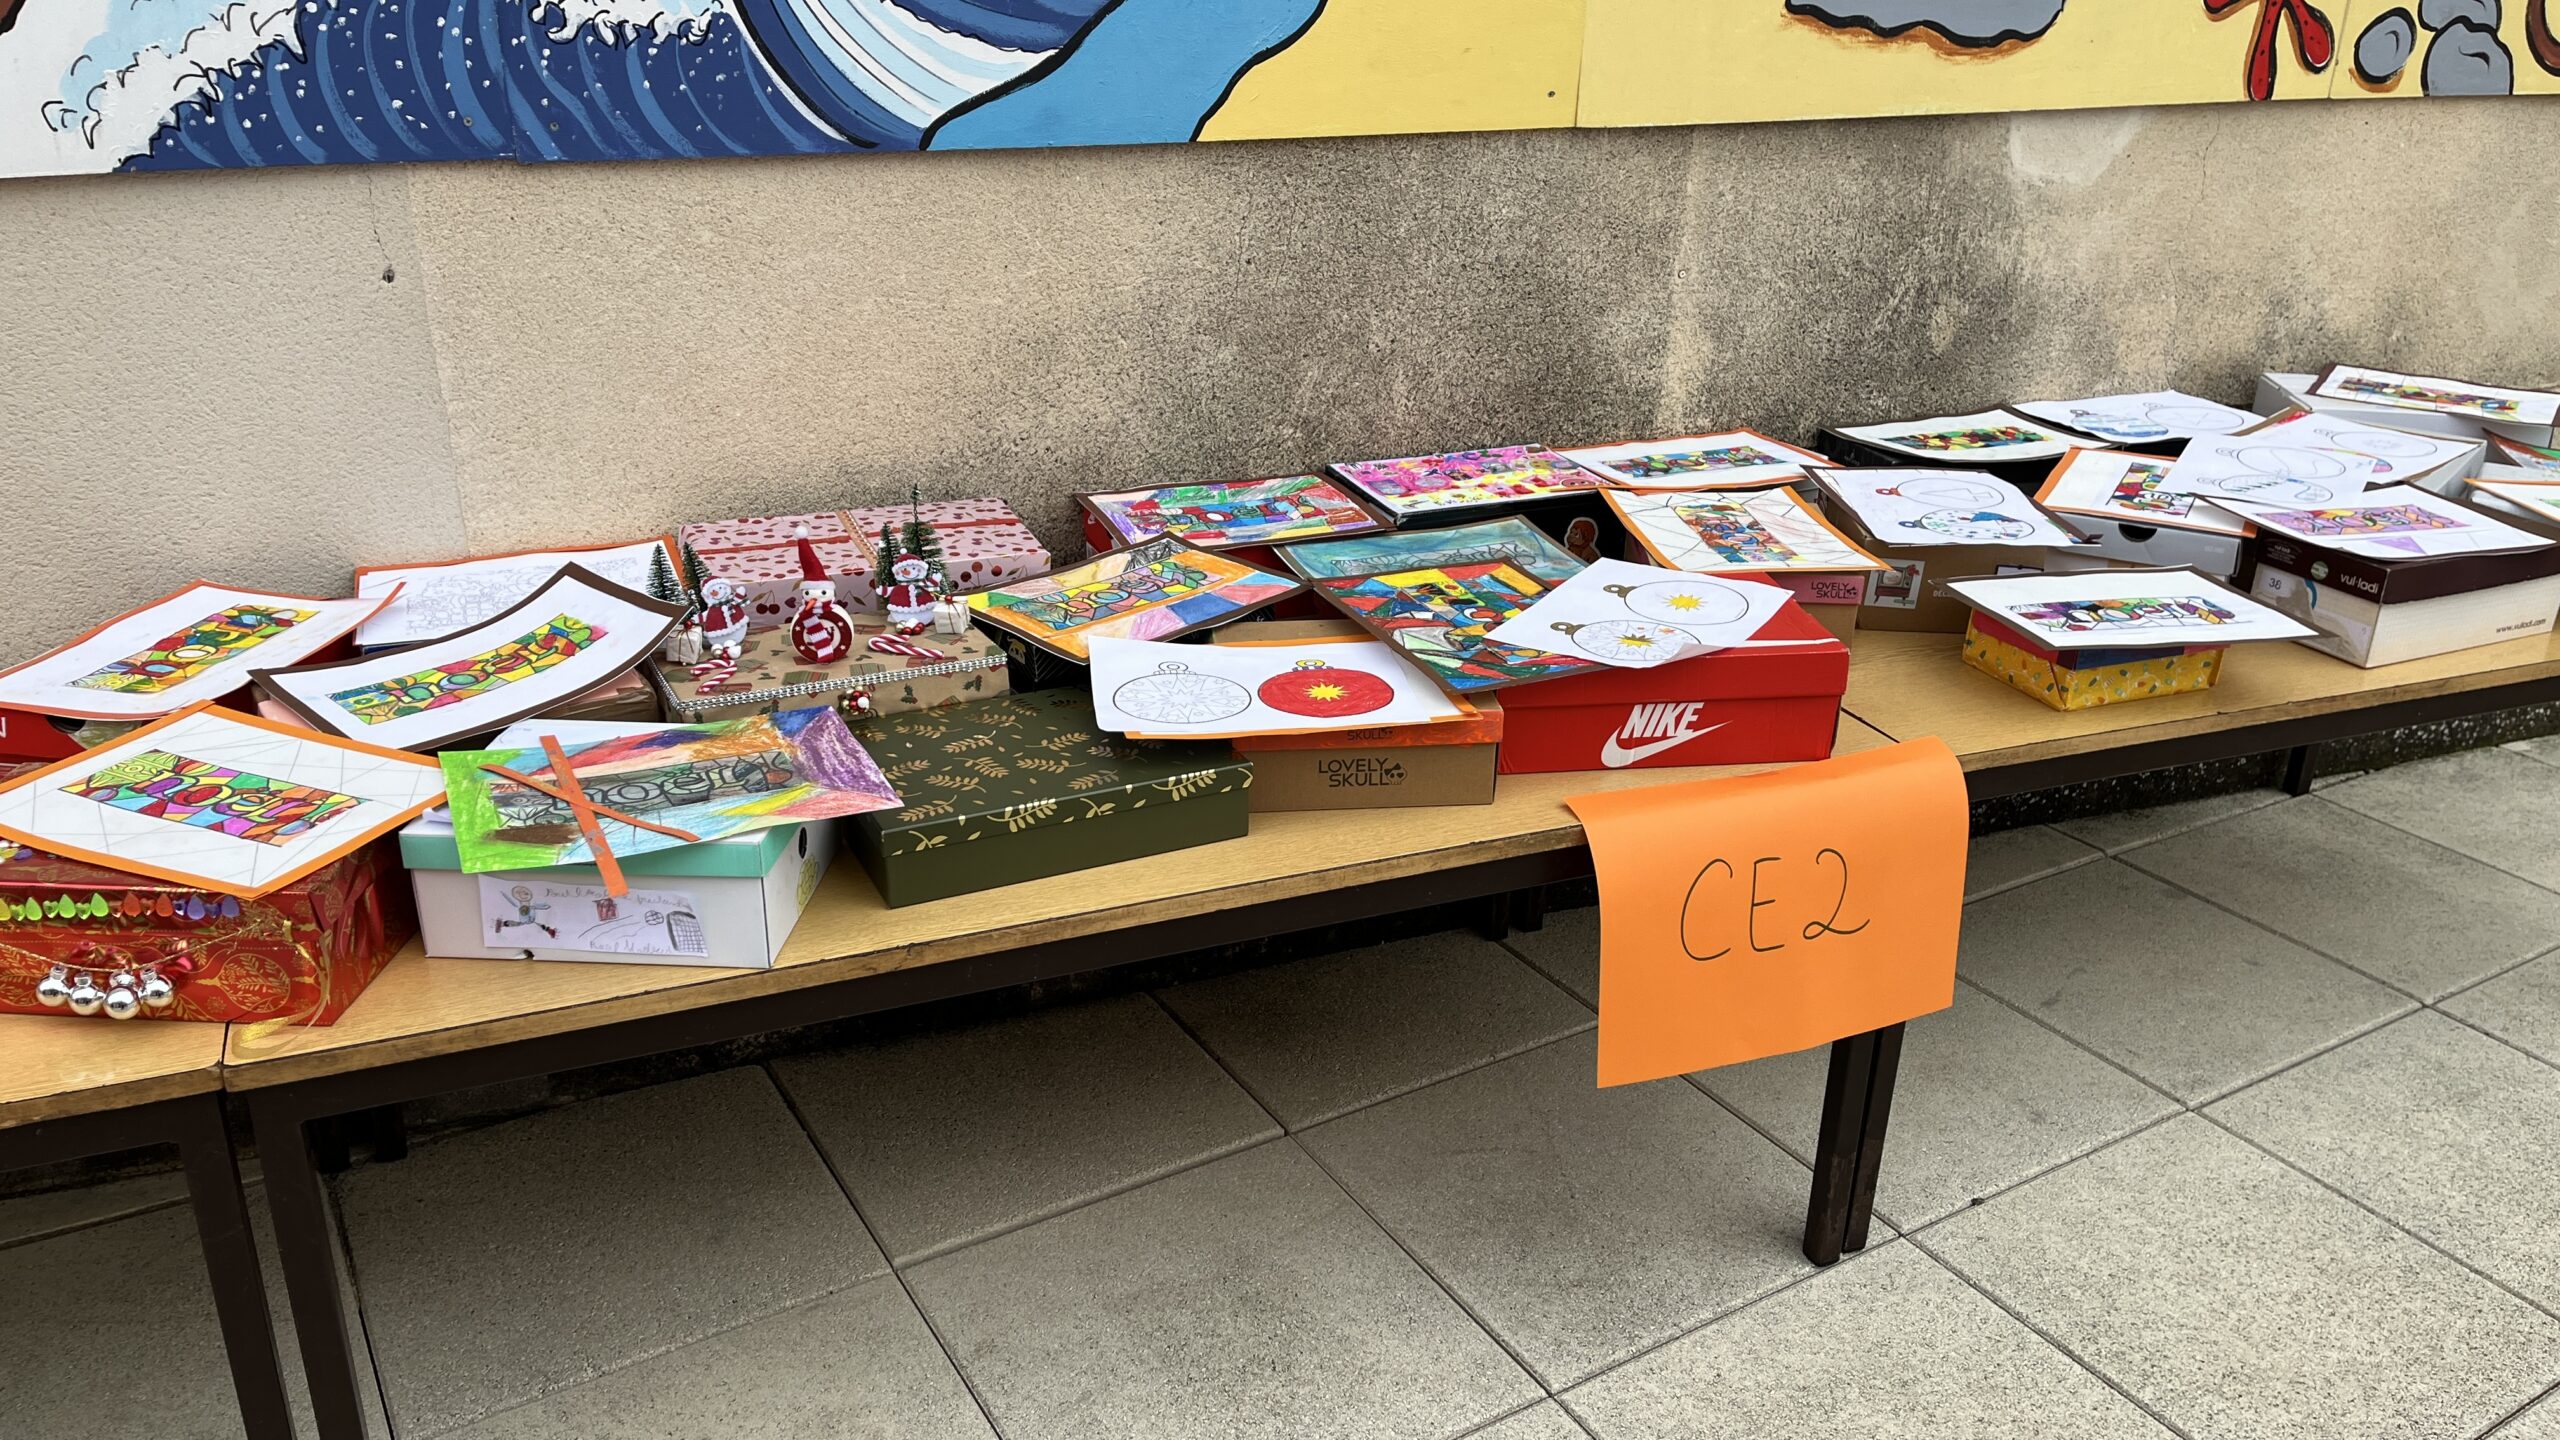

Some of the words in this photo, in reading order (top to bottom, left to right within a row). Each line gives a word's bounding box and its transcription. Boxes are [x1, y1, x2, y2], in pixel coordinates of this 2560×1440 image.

[1811, 582, 1849, 591] LOVELY
[2269, 577, 2282, 590] 38
[1816, 589, 1848, 598] SKULL
[1620, 702, 1705, 739] NIKE
[1347, 728, 1387, 741] SKULL
[1318, 757, 1390, 774] LOVELY
[1328, 772, 1390, 788] SKULL
[1680, 847, 1871, 962] CE2
